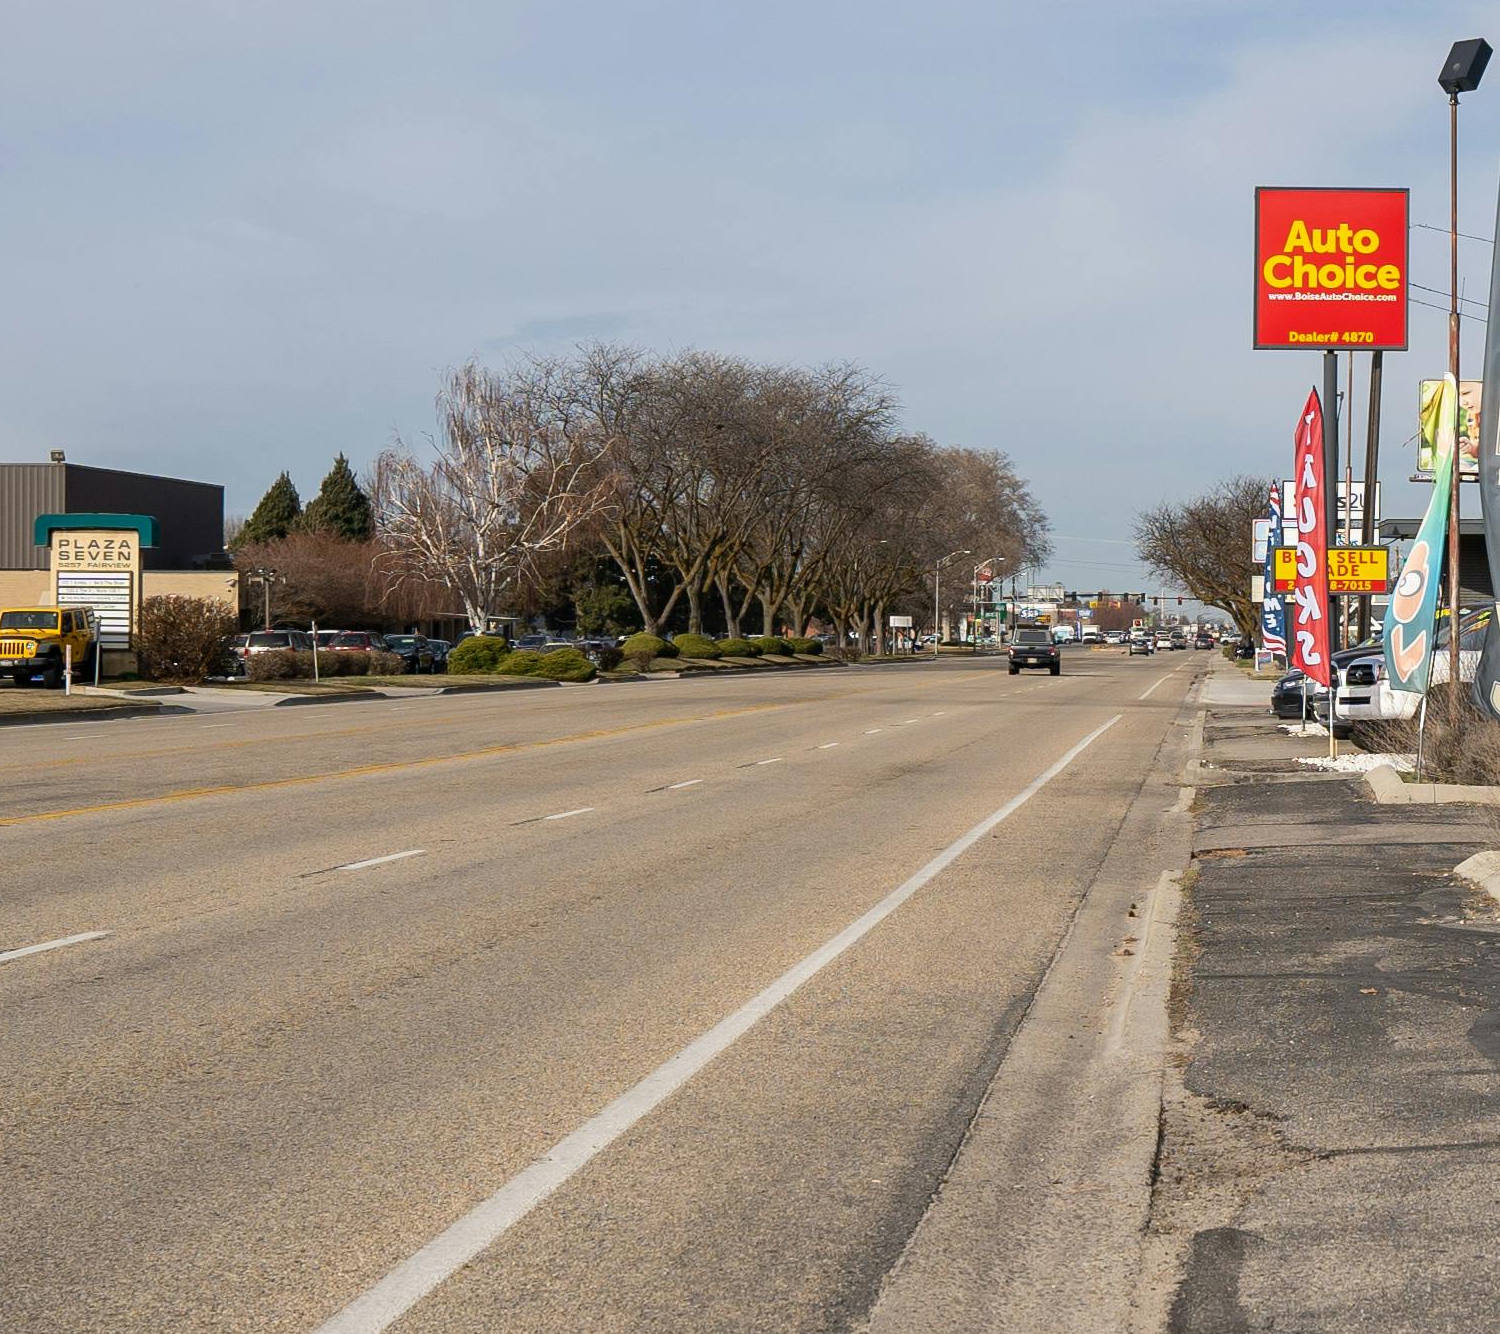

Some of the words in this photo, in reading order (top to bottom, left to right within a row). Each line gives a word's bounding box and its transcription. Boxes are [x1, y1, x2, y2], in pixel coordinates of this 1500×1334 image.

[1283, 220, 1380, 255] Auto
[1263, 254, 1401, 290] Choice
[1268, 291, 1397, 302] www.BoiseAutoChoice.com
[1289, 331, 1339, 343] Dealer#
[1341, 331, 1374, 343] 4870
[58, 539, 132, 550] PLAZA
[58, 550, 131, 561] SEVEN
[1336, 551, 1379, 564] SELL
